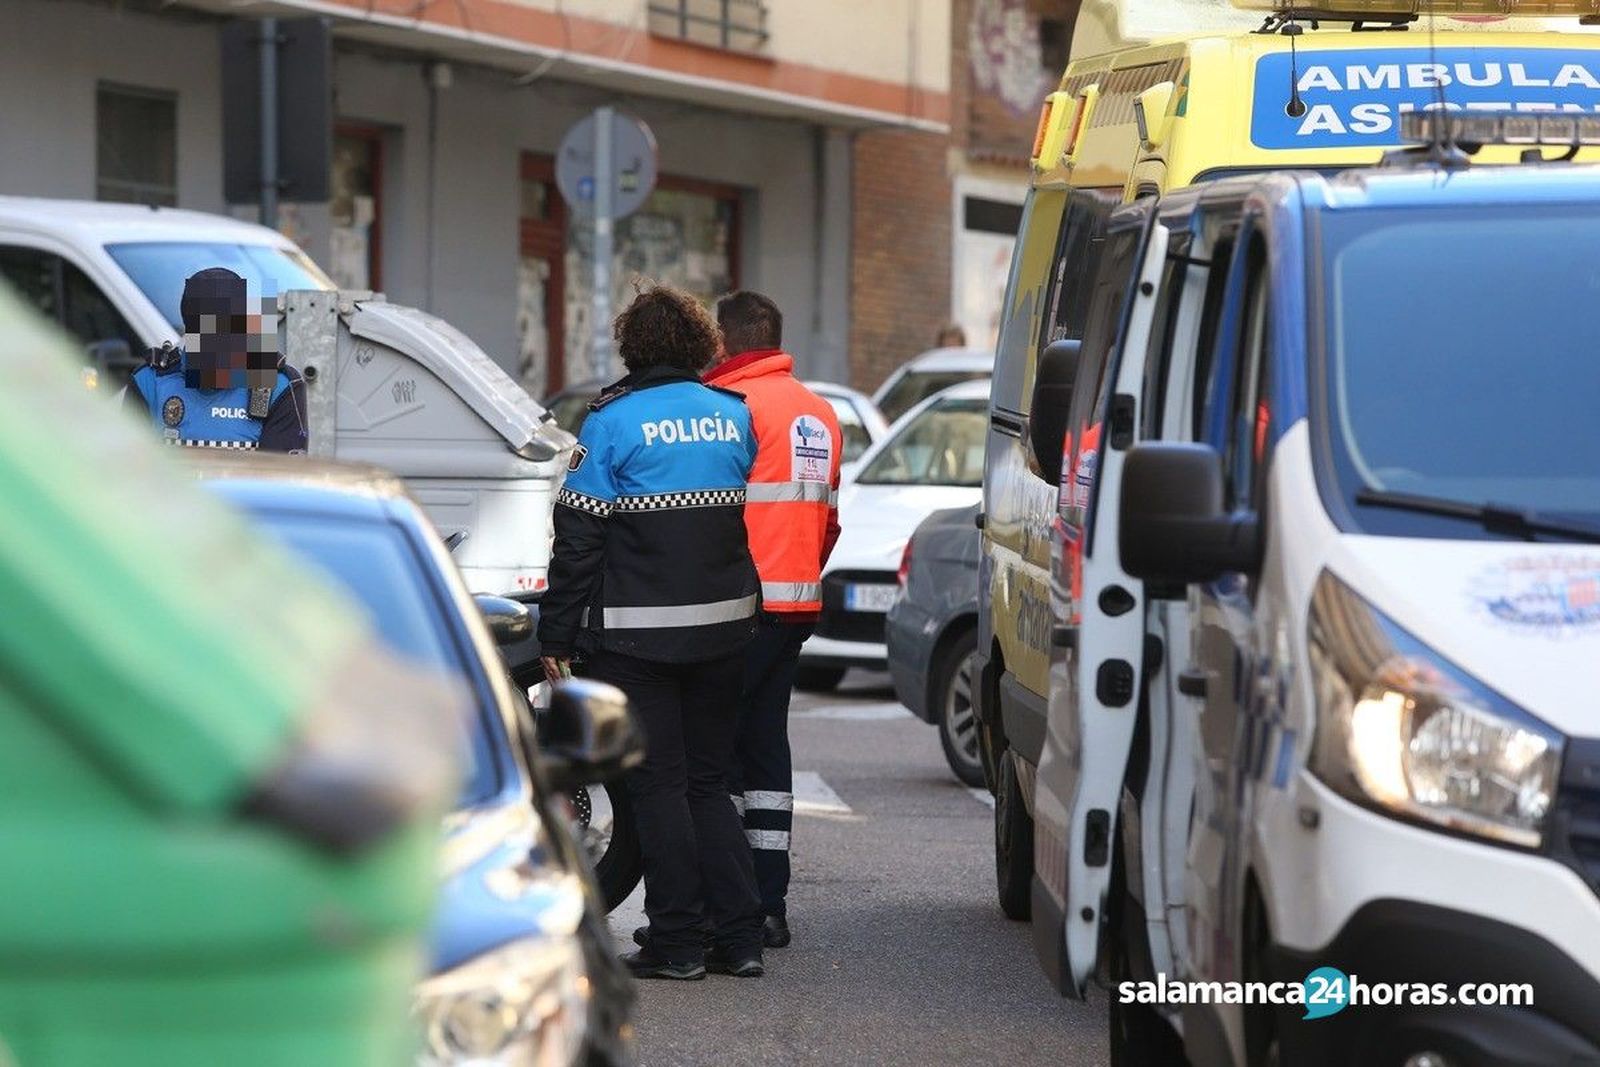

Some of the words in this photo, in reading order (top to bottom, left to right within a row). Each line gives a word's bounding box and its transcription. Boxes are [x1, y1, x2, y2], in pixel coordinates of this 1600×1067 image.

[1296, 63, 1600, 92] AMBULA
[211, 407, 250, 420] POLIC
[641, 411, 741, 447] POLICÍA
